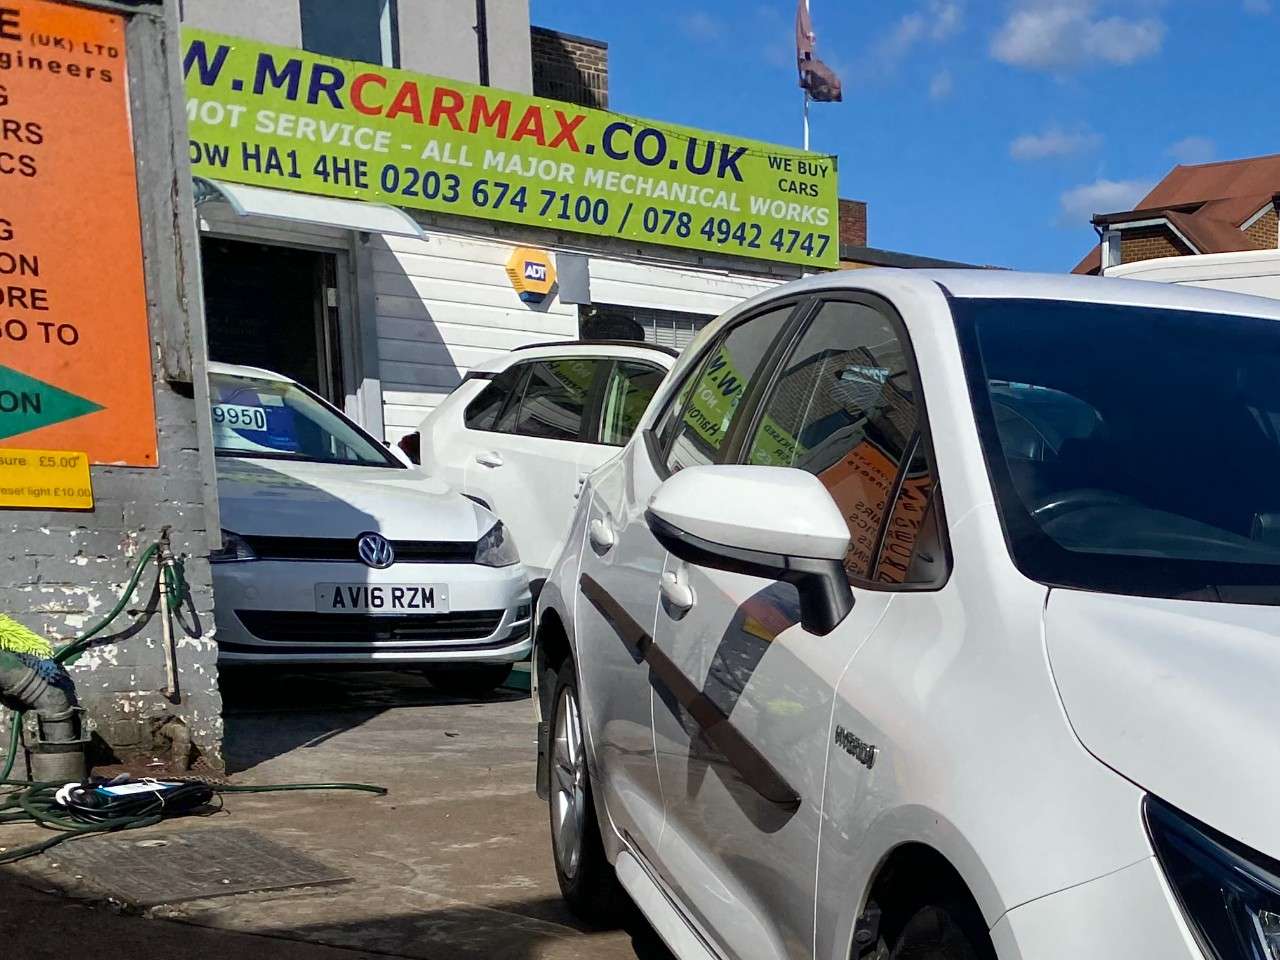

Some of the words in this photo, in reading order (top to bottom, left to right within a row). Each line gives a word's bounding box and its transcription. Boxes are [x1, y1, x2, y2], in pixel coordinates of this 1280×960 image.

[30, 33, 73, 52] (UK)
[83, 42, 119, 58] LTD
[255, 110, 392, 153] SERVICE
[421, 140, 473, 168] ALL
[482, 149, 575, 185] MAJOR
[584, 168, 741, 212] MECHANICAL
[750, 197, 830, 227] WORKS
[768, 155, 792, 173] WE
[798, 161, 828, 179] BUY
[778, 178, 818, 197] CARS
[242, 142, 301, 179] HA1
[314, 155, 369, 189] 4HE
[381, 164, 460, 203] 0203
[472, 179, 527, 214] 674
[540, 190, 609, 225] 7100
[643, 207, 692, 238] 078
[700, 217, 762, 249] 4942
[770, 228, 830, 258] 4747
[525, 263, 545, 280] ADT
[0, 286, 49, 311] RE
[37, 321, 79, 346] TO
[213, 406, 265, 429] 9950
[332, 586, 384, 609] AV16
[391, 587, 435, 609] RZM
